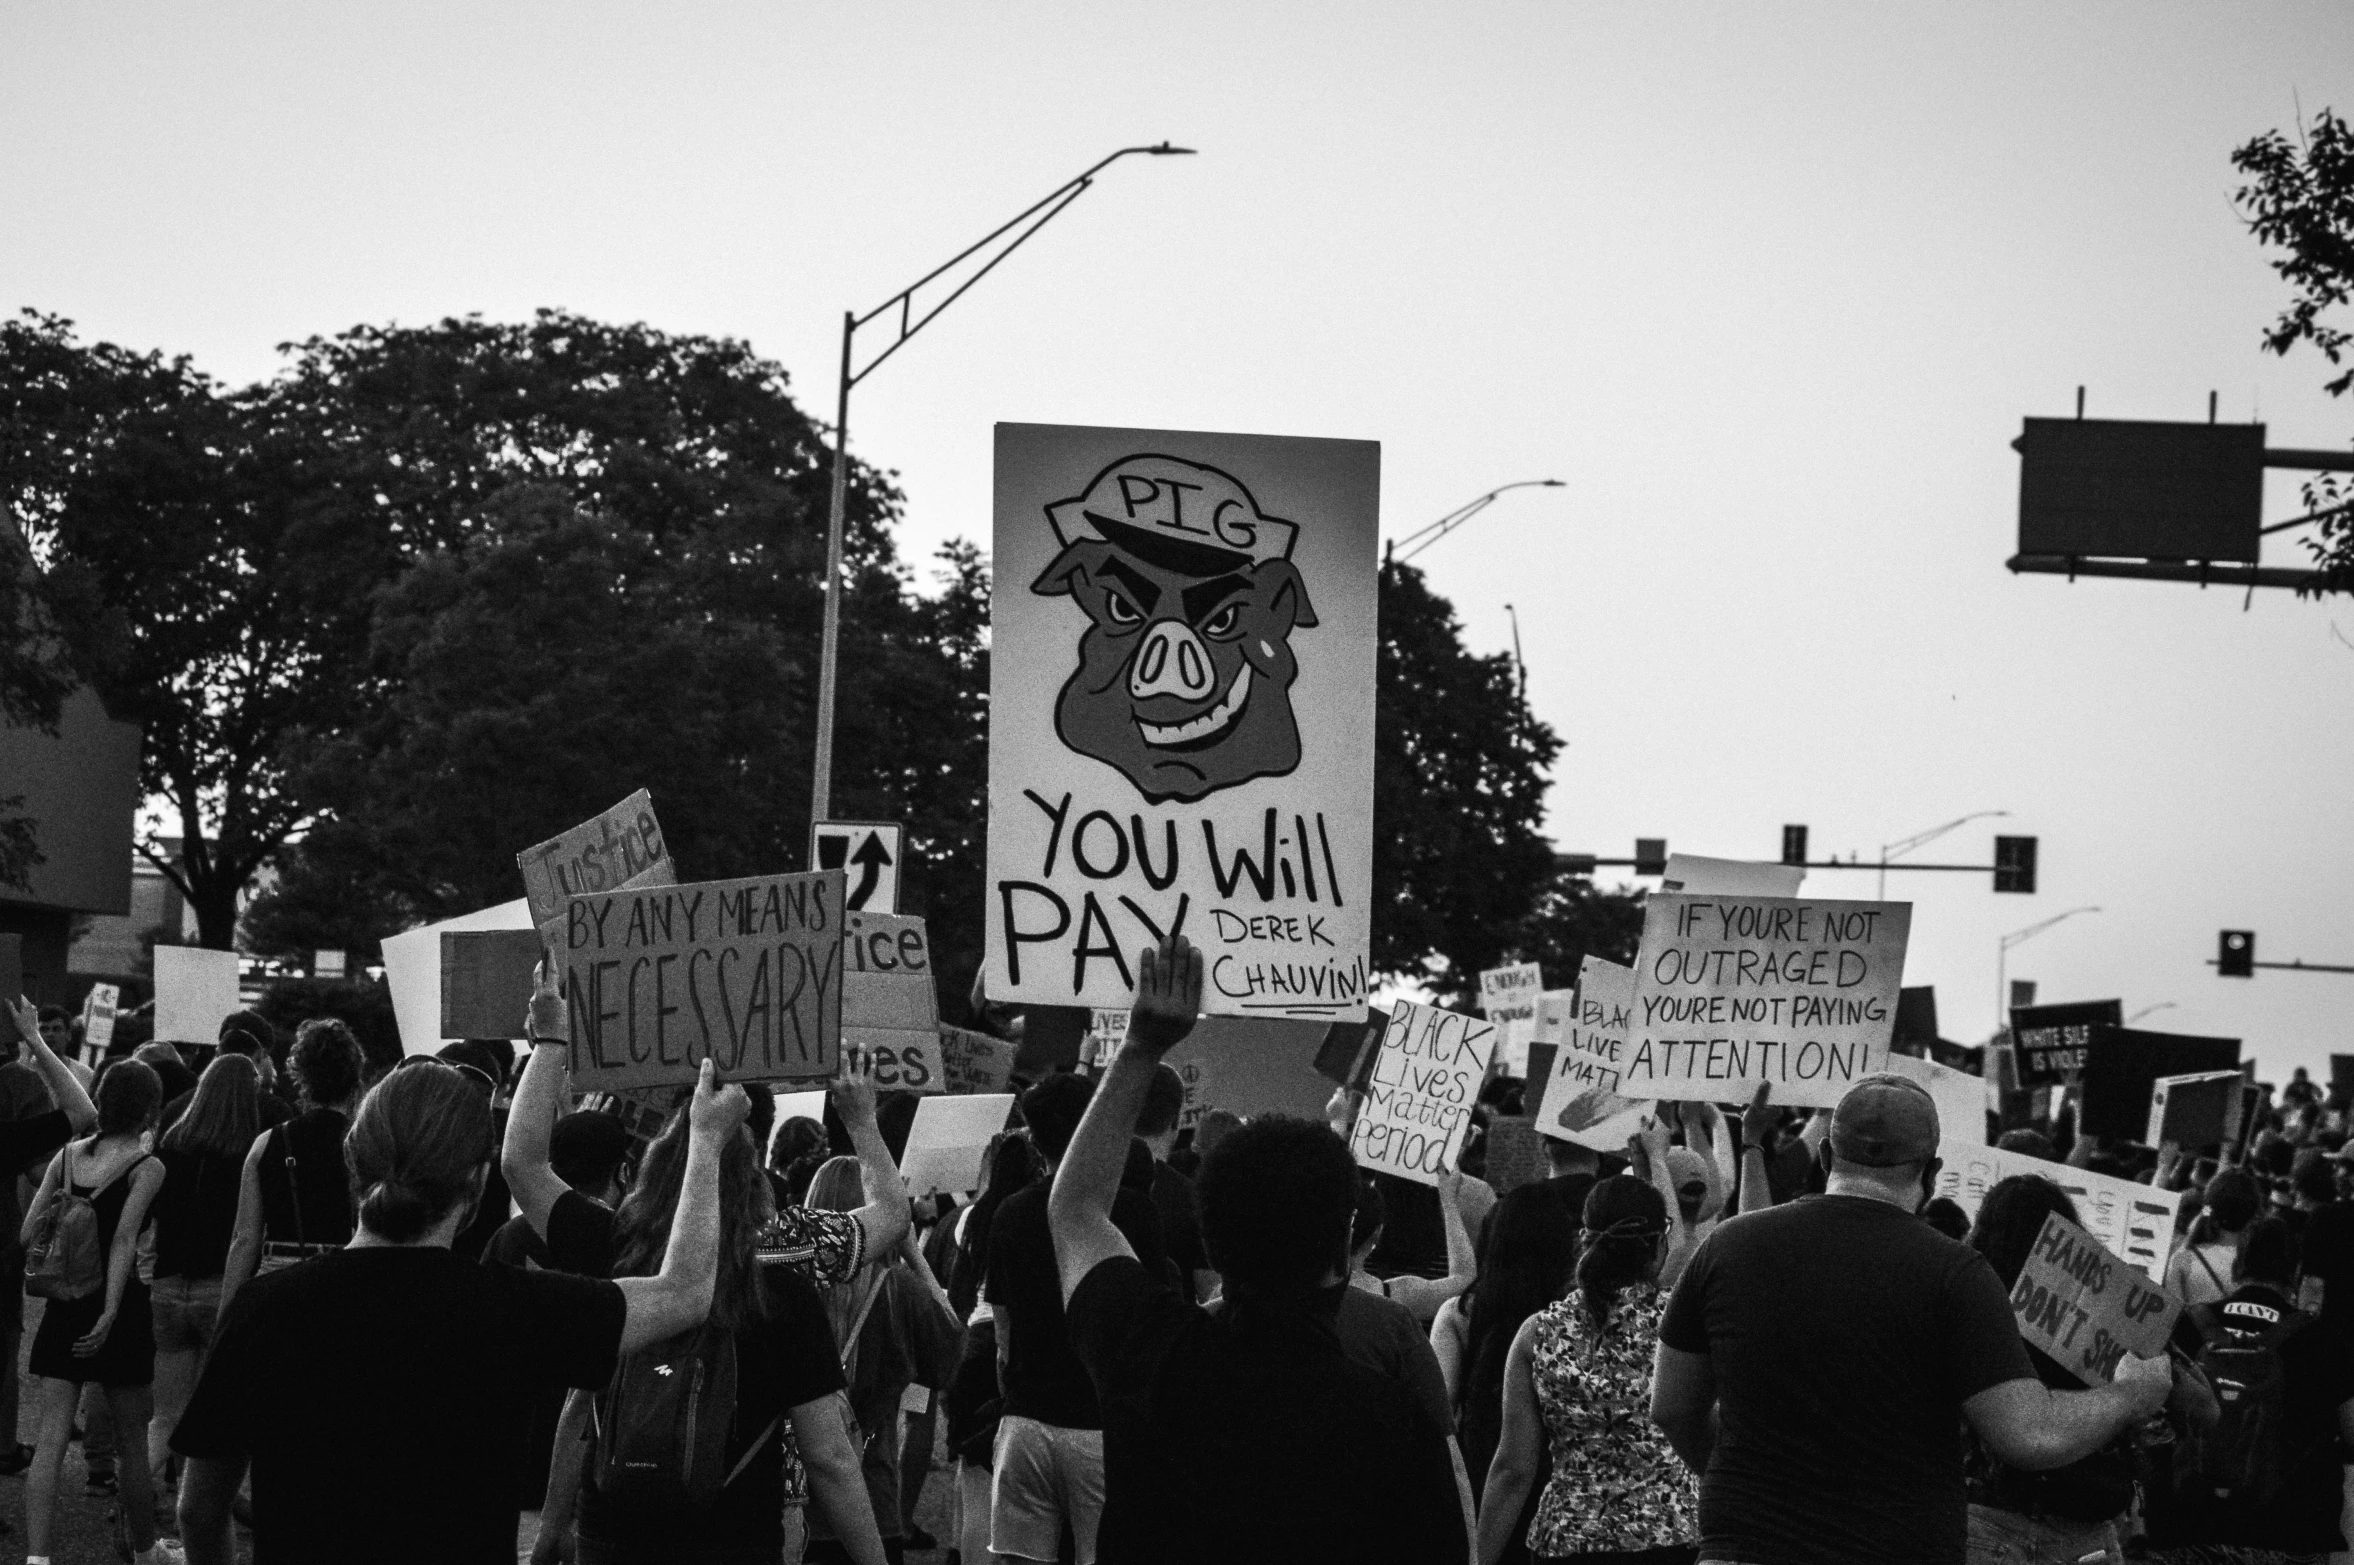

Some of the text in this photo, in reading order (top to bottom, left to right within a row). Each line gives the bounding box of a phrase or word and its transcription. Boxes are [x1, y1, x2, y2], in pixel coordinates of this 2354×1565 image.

[1117, 474, 1257, 549] PIG
[523, 811, 662, 909] Justice
[1023, 788, 1343, 907] YOU Will
[568, 879, 827, 949] BY ANY MEANS
[843, 917, 926, 971] ice
[997, 880, 1190, 995] PAY
[1209, 909, 1335, 946] DEREK
[1677, 903, 1881, 943] IF YOURE NOT
[1654, 948, 1867, 987] OUTRAGED
[567, 940, 839, 1075] NECESSARY
[1384, 999, 1494, 1071] BLACK
[1643, 995, 1888, 1028] YOURE NOT PAYING
[1373, 1051, 1469, 1104] Lives
[1572, 1028, 1622, 1062] LIVE
[1366, 1085, 1471, 1131] Matter
[2034, 1219, 2165, 1324] HANDS UP
[2012, 1273, 2090, 1349] DON'T
